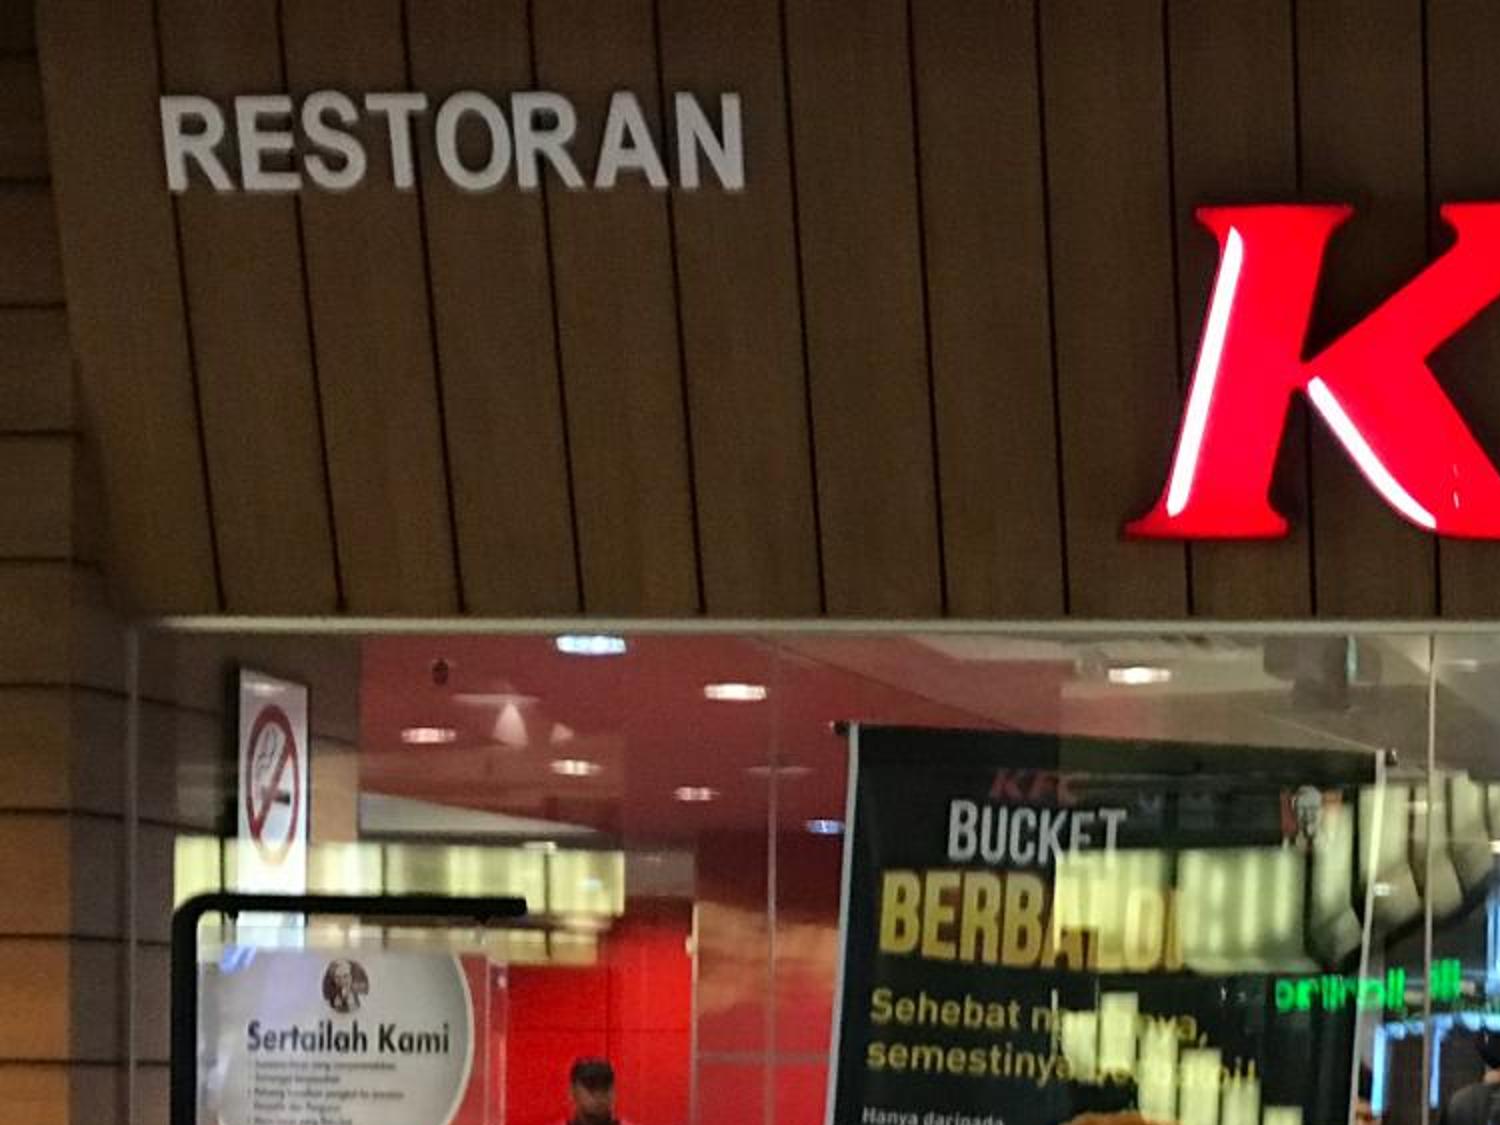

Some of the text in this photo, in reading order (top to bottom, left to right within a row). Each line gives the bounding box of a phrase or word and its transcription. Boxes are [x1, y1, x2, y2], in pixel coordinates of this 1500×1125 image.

[159, 91, 746, 192] RESTORAN
[948, 799, 1127, 867] BUCKET
[870, 986, 1018, 1031] Sehebat
[247, 1020, 449, 1054] Sertailah Kami
[866, 1041, 1072, 1087] semestinya
